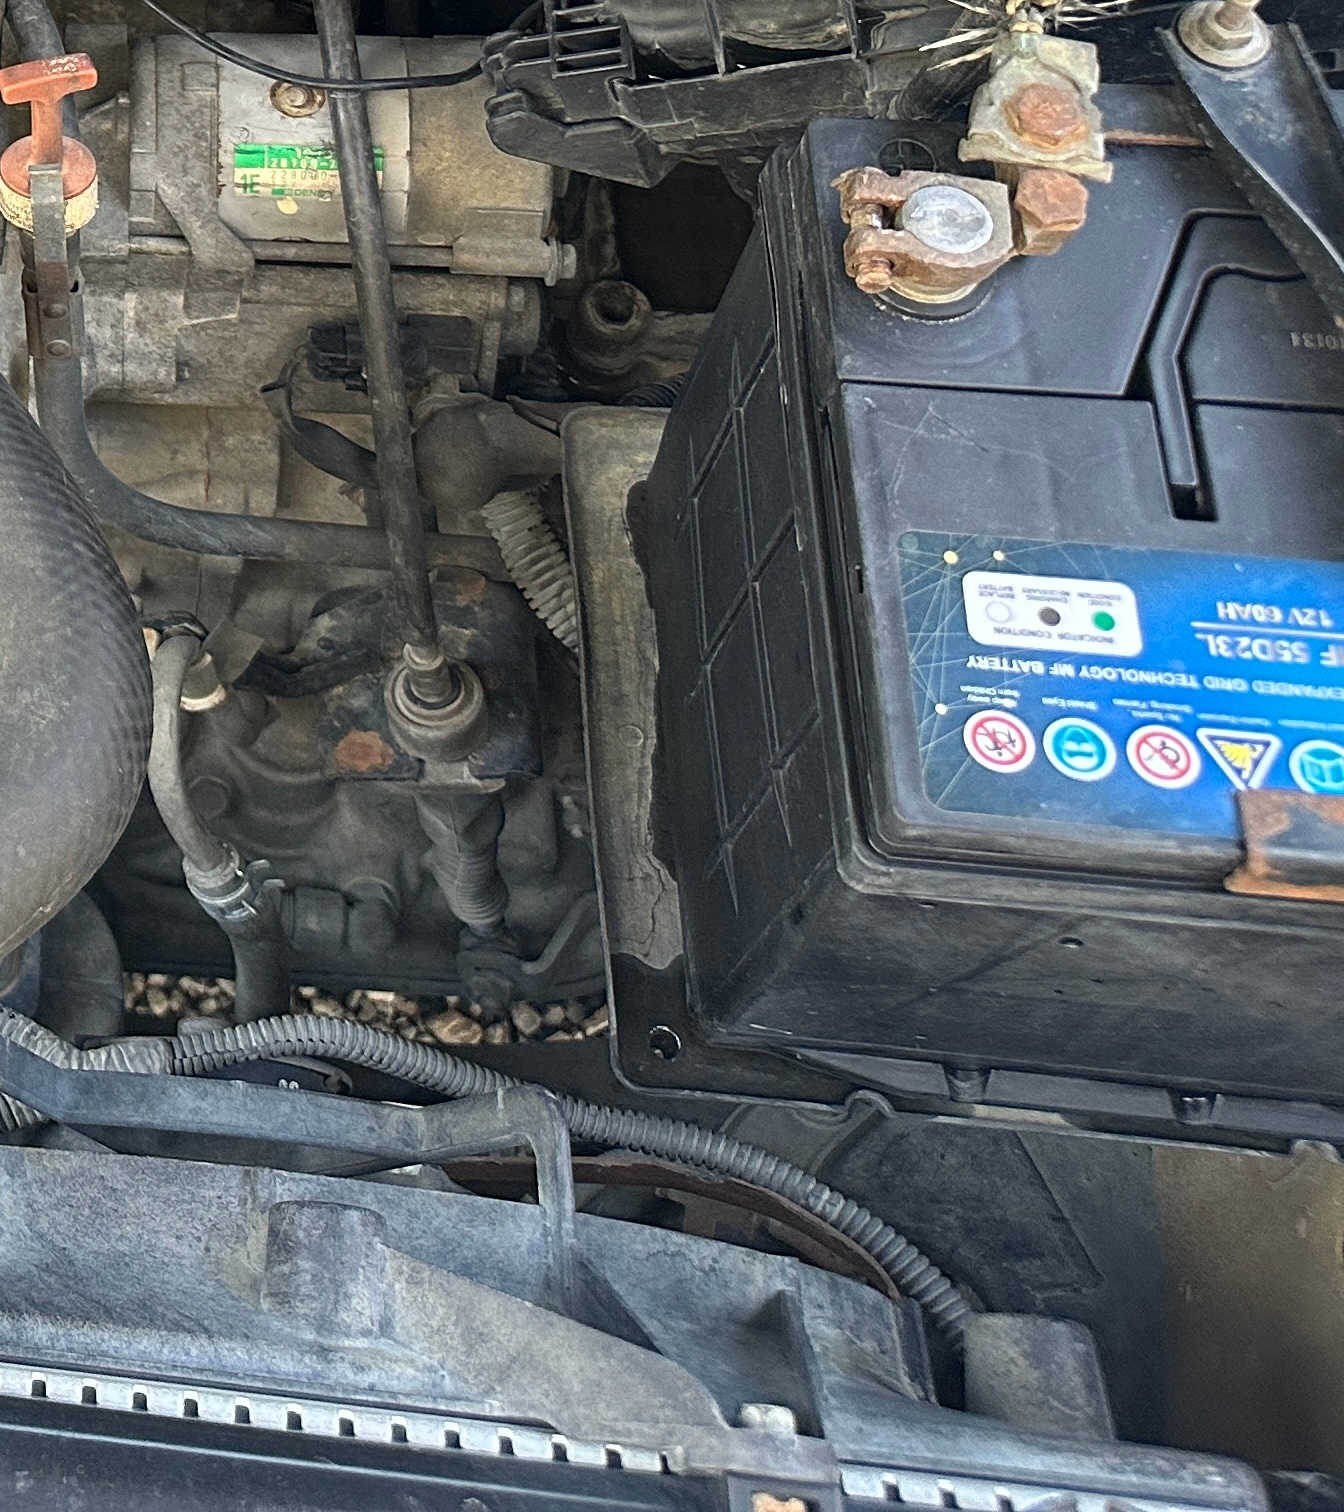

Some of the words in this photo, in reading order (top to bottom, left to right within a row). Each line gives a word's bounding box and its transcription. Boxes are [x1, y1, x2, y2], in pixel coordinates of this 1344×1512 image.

[1287, 607, 1334, 627] 12V
[993, 626, 1053, 639] CONDITION
[1057, 631, 1114, 644] INDICATOR
[1194, 632, 1311, 665] 55D23L
[966, 654, 1046, 675] BATTERY
[1049, 663, 1076, 678] MF
[1079, 664, 1201, 689] TECHNOLOGY
[1202, 675, 1250, 692] GRID
[1042, 696, 1066, 708] Eyes
